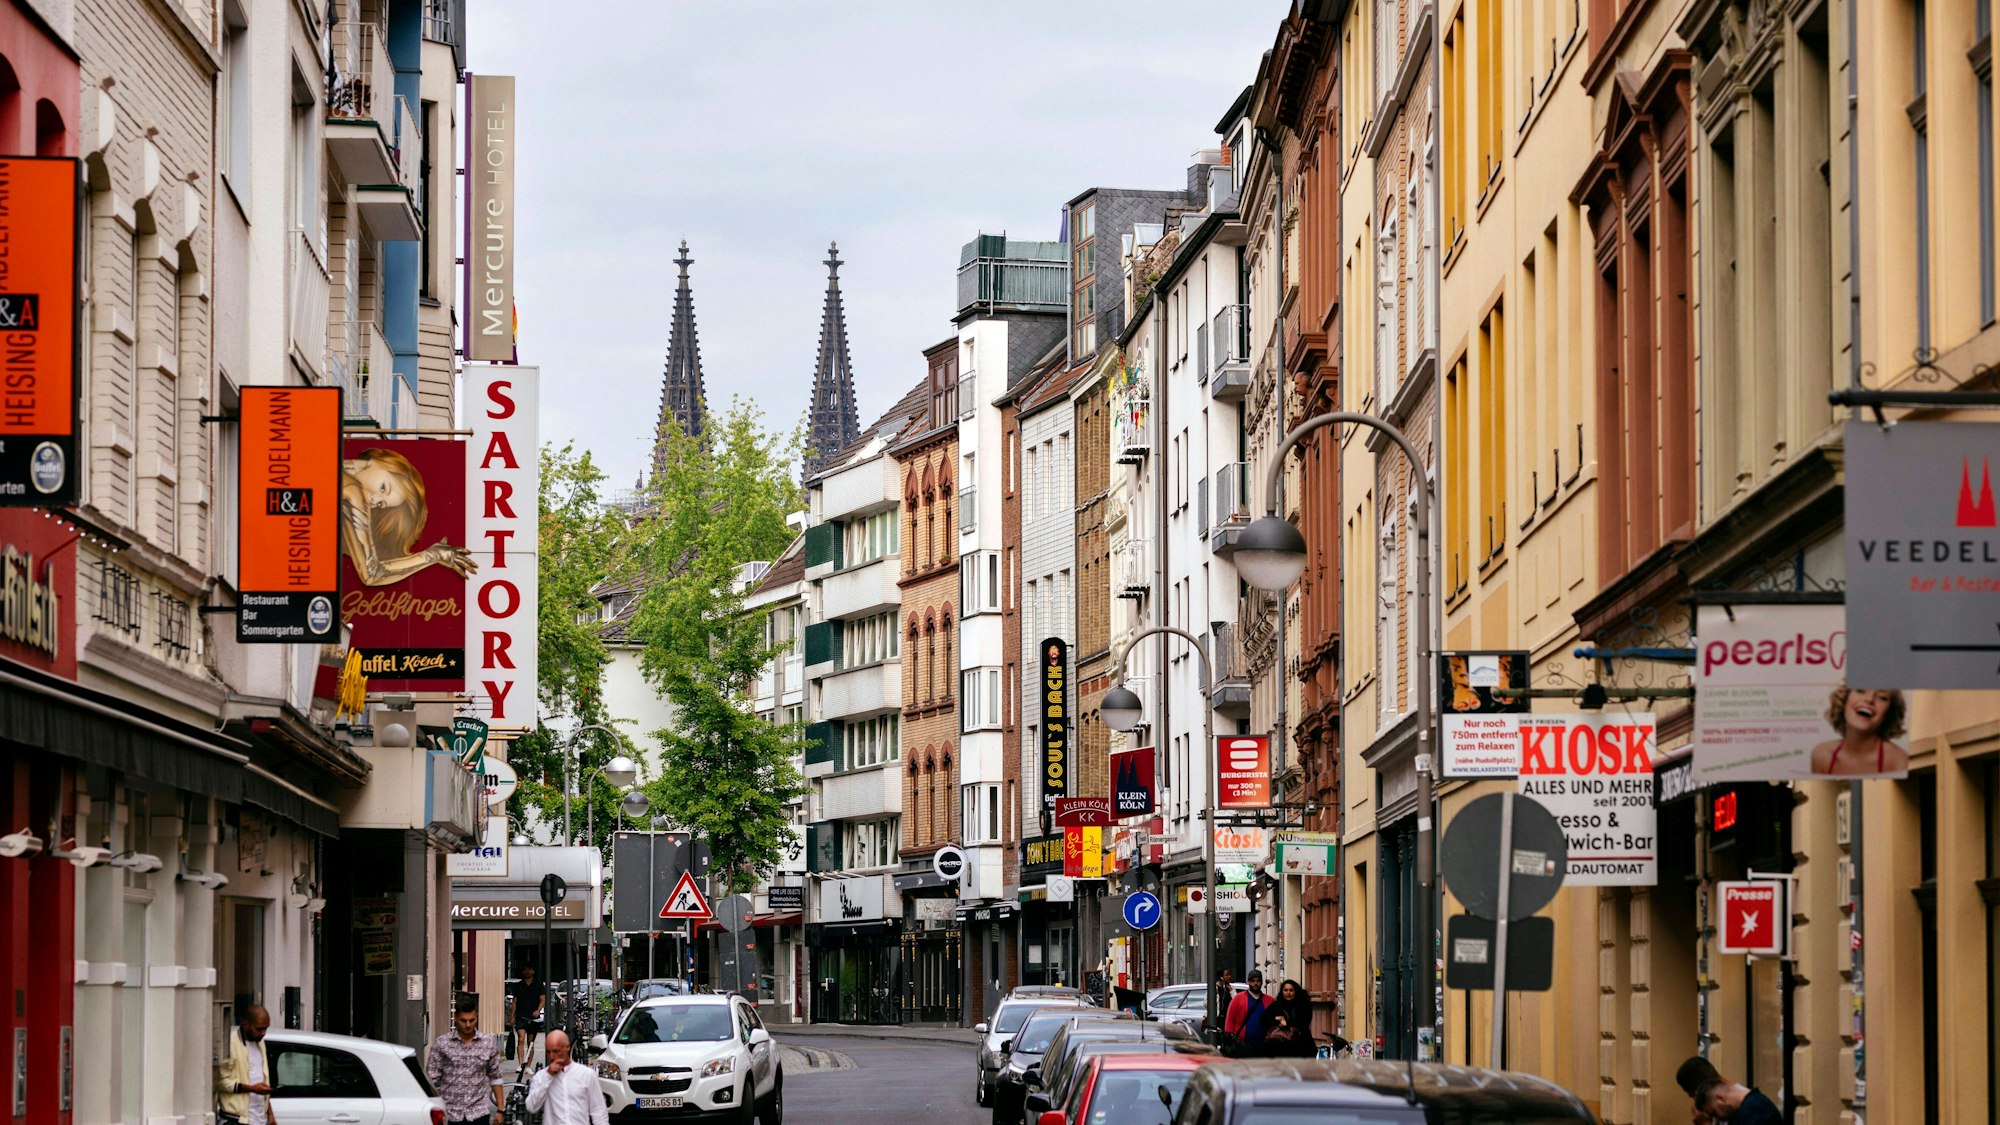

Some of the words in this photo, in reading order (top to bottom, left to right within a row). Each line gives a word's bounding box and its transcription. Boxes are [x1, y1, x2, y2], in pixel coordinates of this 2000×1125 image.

[487, 102, 505, 184] HOTEL
[482, 198, 504, 335] Mercure
[5, 333, 37, 426] HEISING
[268, 391, 291, 486] ADELMANN
[269, 490, 309, 513] H&A
[288, 517, 311, 585] HEISING
[477, 380, 521, 719] SARTORY
[1859, 540, 1998, 562] VEEDEL
[1910, 575, 1935, 592] Bar
[243, 594, 289, 605] Restaurant
[341, 590, 462, 623] Goldfinger
[242, 609, 258, 620] Bar
[242, 624, 304, 637] Sommergarten
[362, 655, 397, 673] affel
[400, 653, 447, 672] Kölsch
[1704, 633, 1827, 677] pearls
[1047, 665, 1063, 718] BACK
[1463, 719, 1480, 728] Nur
[1483, 719, 1506, 728] noch
[1452, 730, 1478, 739] 750m
[1481, 730, 1518, 739] entfernt
[1478, 742, 1515, 750] Relaxen
[1519, 724, 1654, 776] KIOSK
[1047, 723, 1064, 788] SOUL'S
[1221, 771, 1268, 779] BURGERISTA
[1523, 781, 1566, 795] ALLES
[1571, 780, 1604, 794] UND
[1609, 780, 1652, 794] MEHR
[1118, 792, 1147, 800] KLEIN
[1593, 796, 1617, 807] seit
[1622, 796, 1653, 807] 2001
[1063, 800, 1087, 811] KLEIN
[1088, 800, 1109, 810] KÖLN
[1119, 801, 1145, 809] KÖLN
[1554, 815, 1601, 828] esso
[1608, 812, 1620, 828] &
[1214, 827, 1264, 848] Kiosk
[1278, 833, 1293, 841] NU
[1727, 889, 1772, 900] Presse
[975, 909, 990, 920] MIKRO
[641, 1099, 656, 1107] BRA
[661, 1099, 671, 1107] GS
[672, 1098, 682, 1106] 81
